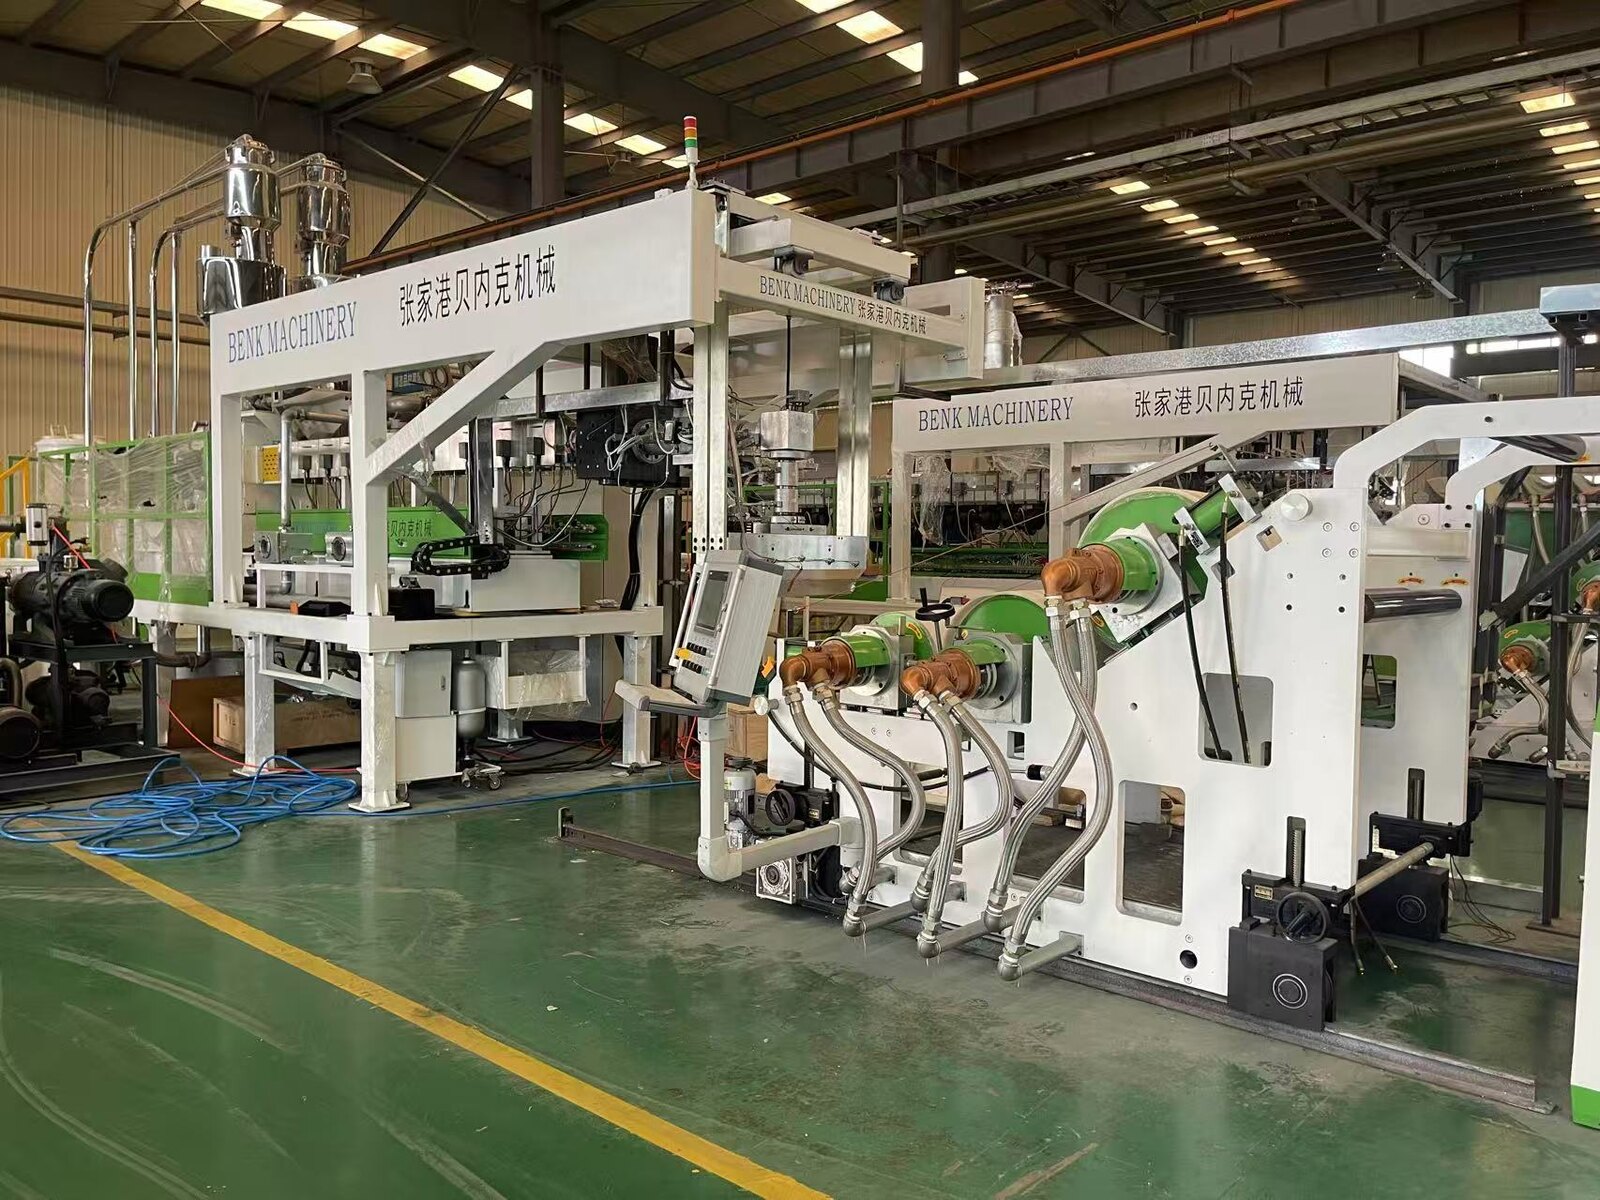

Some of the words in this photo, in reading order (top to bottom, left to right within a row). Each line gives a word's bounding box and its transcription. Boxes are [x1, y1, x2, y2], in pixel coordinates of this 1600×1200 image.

[399, 244, 556, 327] 张家港贝内克机械
[760, 275, 791, 299] BENK
[793, 282, 856, 315] MACHINERY
[228, 324, 265, 363] BENK
[267, 301, 357, 354] MACHINERY
[857, 299, 927, 335] 张家港贝内克机械
[918, 407, 963, 432] BENK
[967, 397, 1074, 427] MACHINERY
[1134, 376, 1304, 418] 张家港贝内克机械
[387, 518, 433, 538] 贝内克机械
